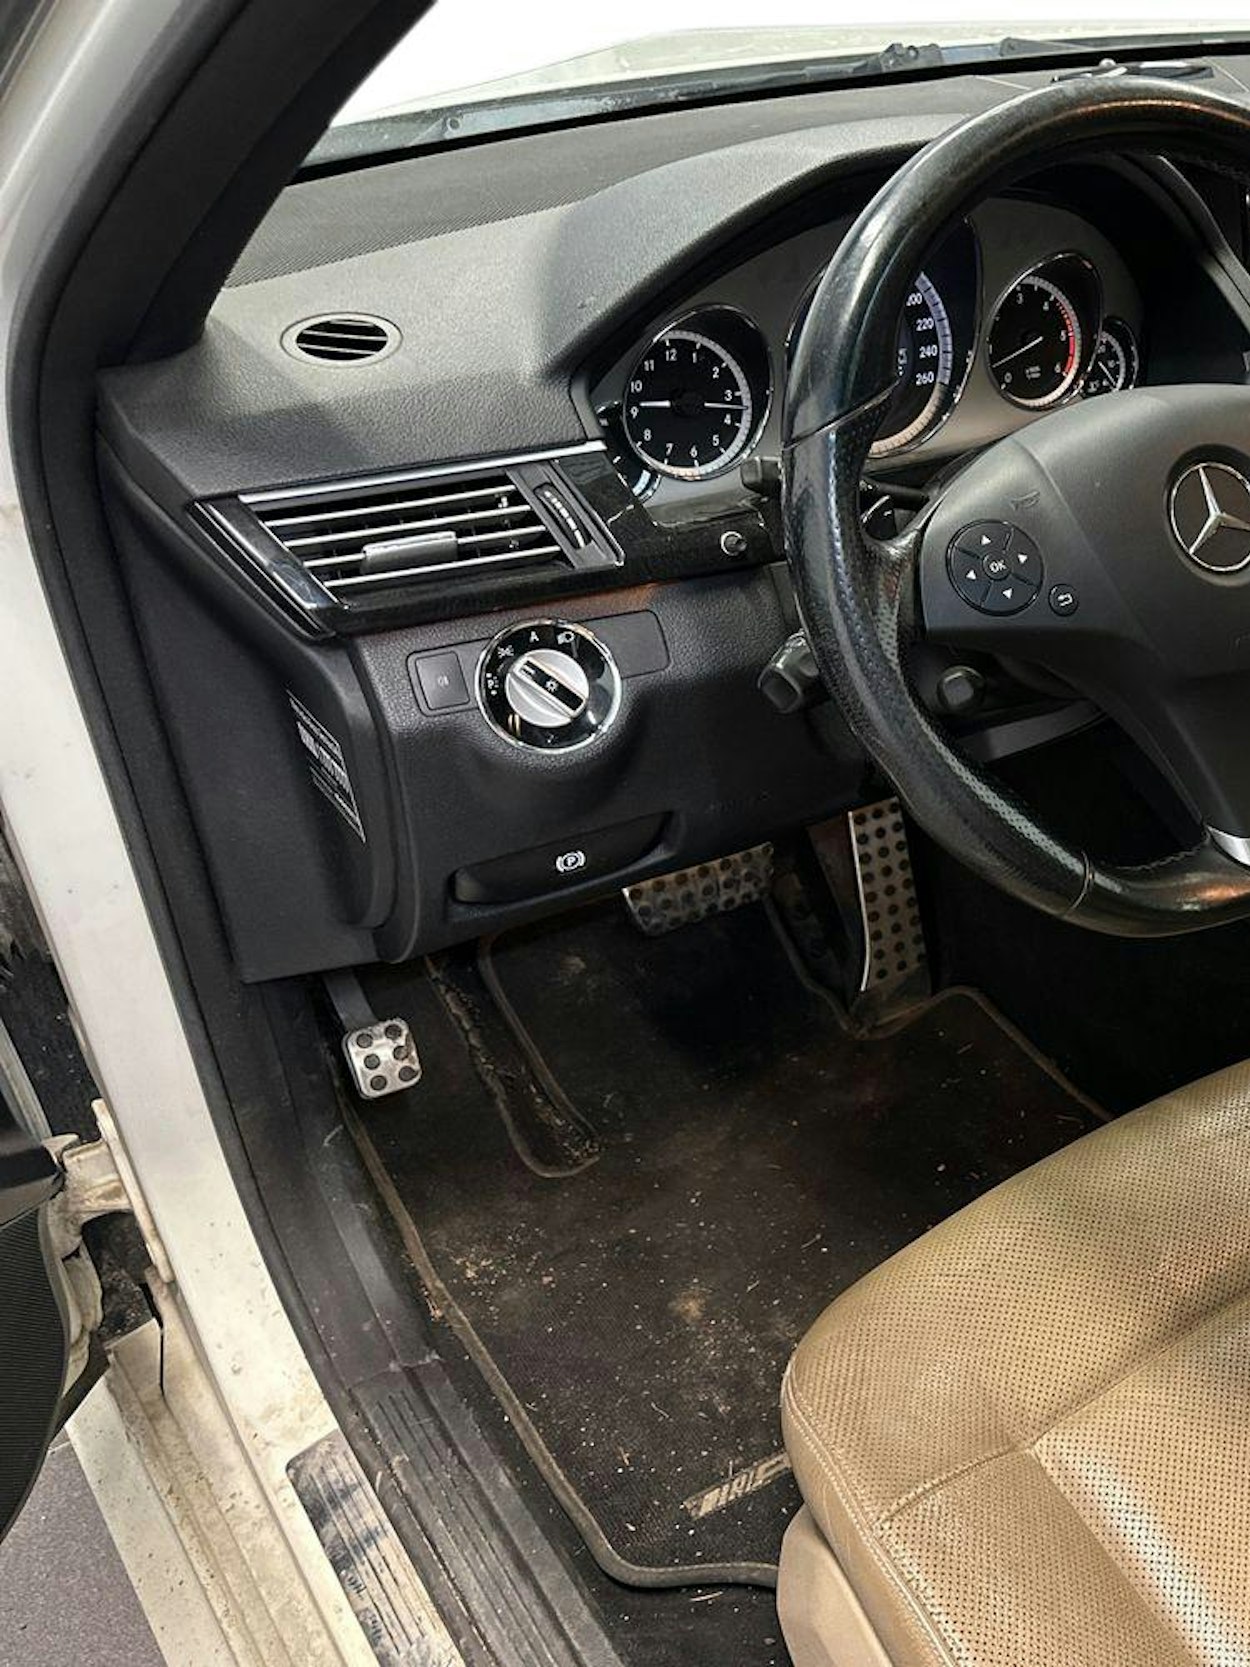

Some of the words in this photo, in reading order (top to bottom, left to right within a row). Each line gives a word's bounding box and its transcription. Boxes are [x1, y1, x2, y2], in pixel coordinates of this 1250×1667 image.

[915, 317, 935, 332] 220
[665, 348, 678, 361] 12
[692, 351, 698, 363] 1
[919, 344, 939, 359] 240
[643, 359, 655, 372] 11
[712, 366, 720, 379] 2
[915, 371, 935, 386] 260
[630, 380, 643, 393] 10
[724, 389, 733, 402] 3
[630, 406, 639, 419] 9
[723, 413, 731, 425] 4
[643, 428, 652, 441] 8
[712, 434, 720, 447] 5
[665, 442, 674, 456] 7
[689, 445, 698, 458] 6
[988, 559, 1008, 574] OK
[529, 630, 540, 643] A
